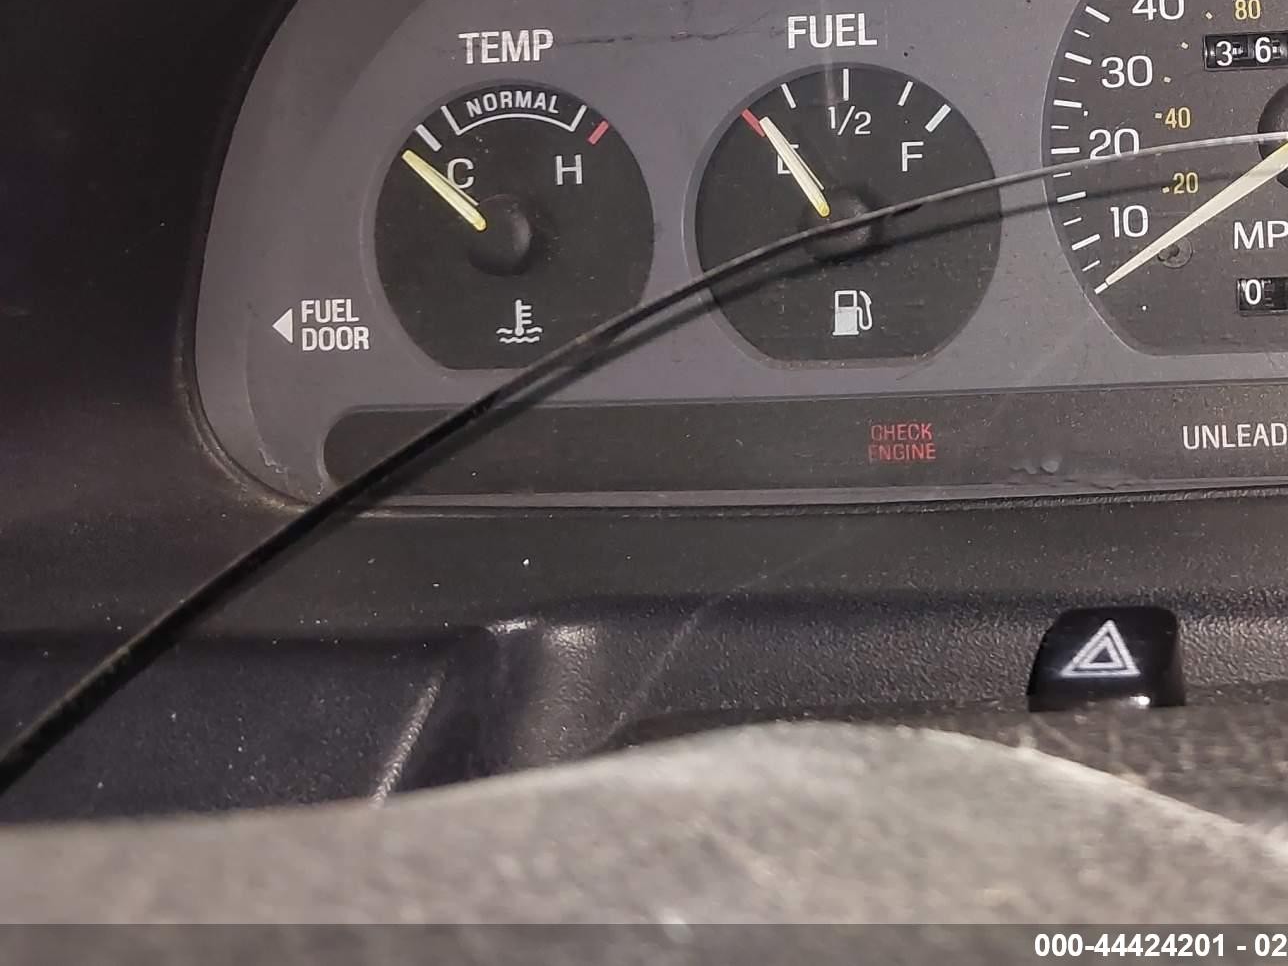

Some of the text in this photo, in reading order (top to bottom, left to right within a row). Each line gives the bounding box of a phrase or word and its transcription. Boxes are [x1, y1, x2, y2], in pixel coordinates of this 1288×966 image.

[787, 13, 878, 49] FUEL
[458, 29, 554, 65] TEMP
[1101, 55, 1153, 87] 30
[465, 90, 559, 118] NORMAL
[1164, 107, 1191, 129] 40
[901, 141, 925, 172] F
[1089, 128, 1140, 160] 20
[447, 158, 475, 189] C
[555, 154, 583, 185] H
[1173, 172, 1199, 194] 20
[1110, 205, 1149, 238] 10
[301, 298, 360, 323] FUEL
[301, 326, 370, 351] DOOR
[870, 422, 933, 441] CHECK
[868, 442, 937, 462] ENGINE
